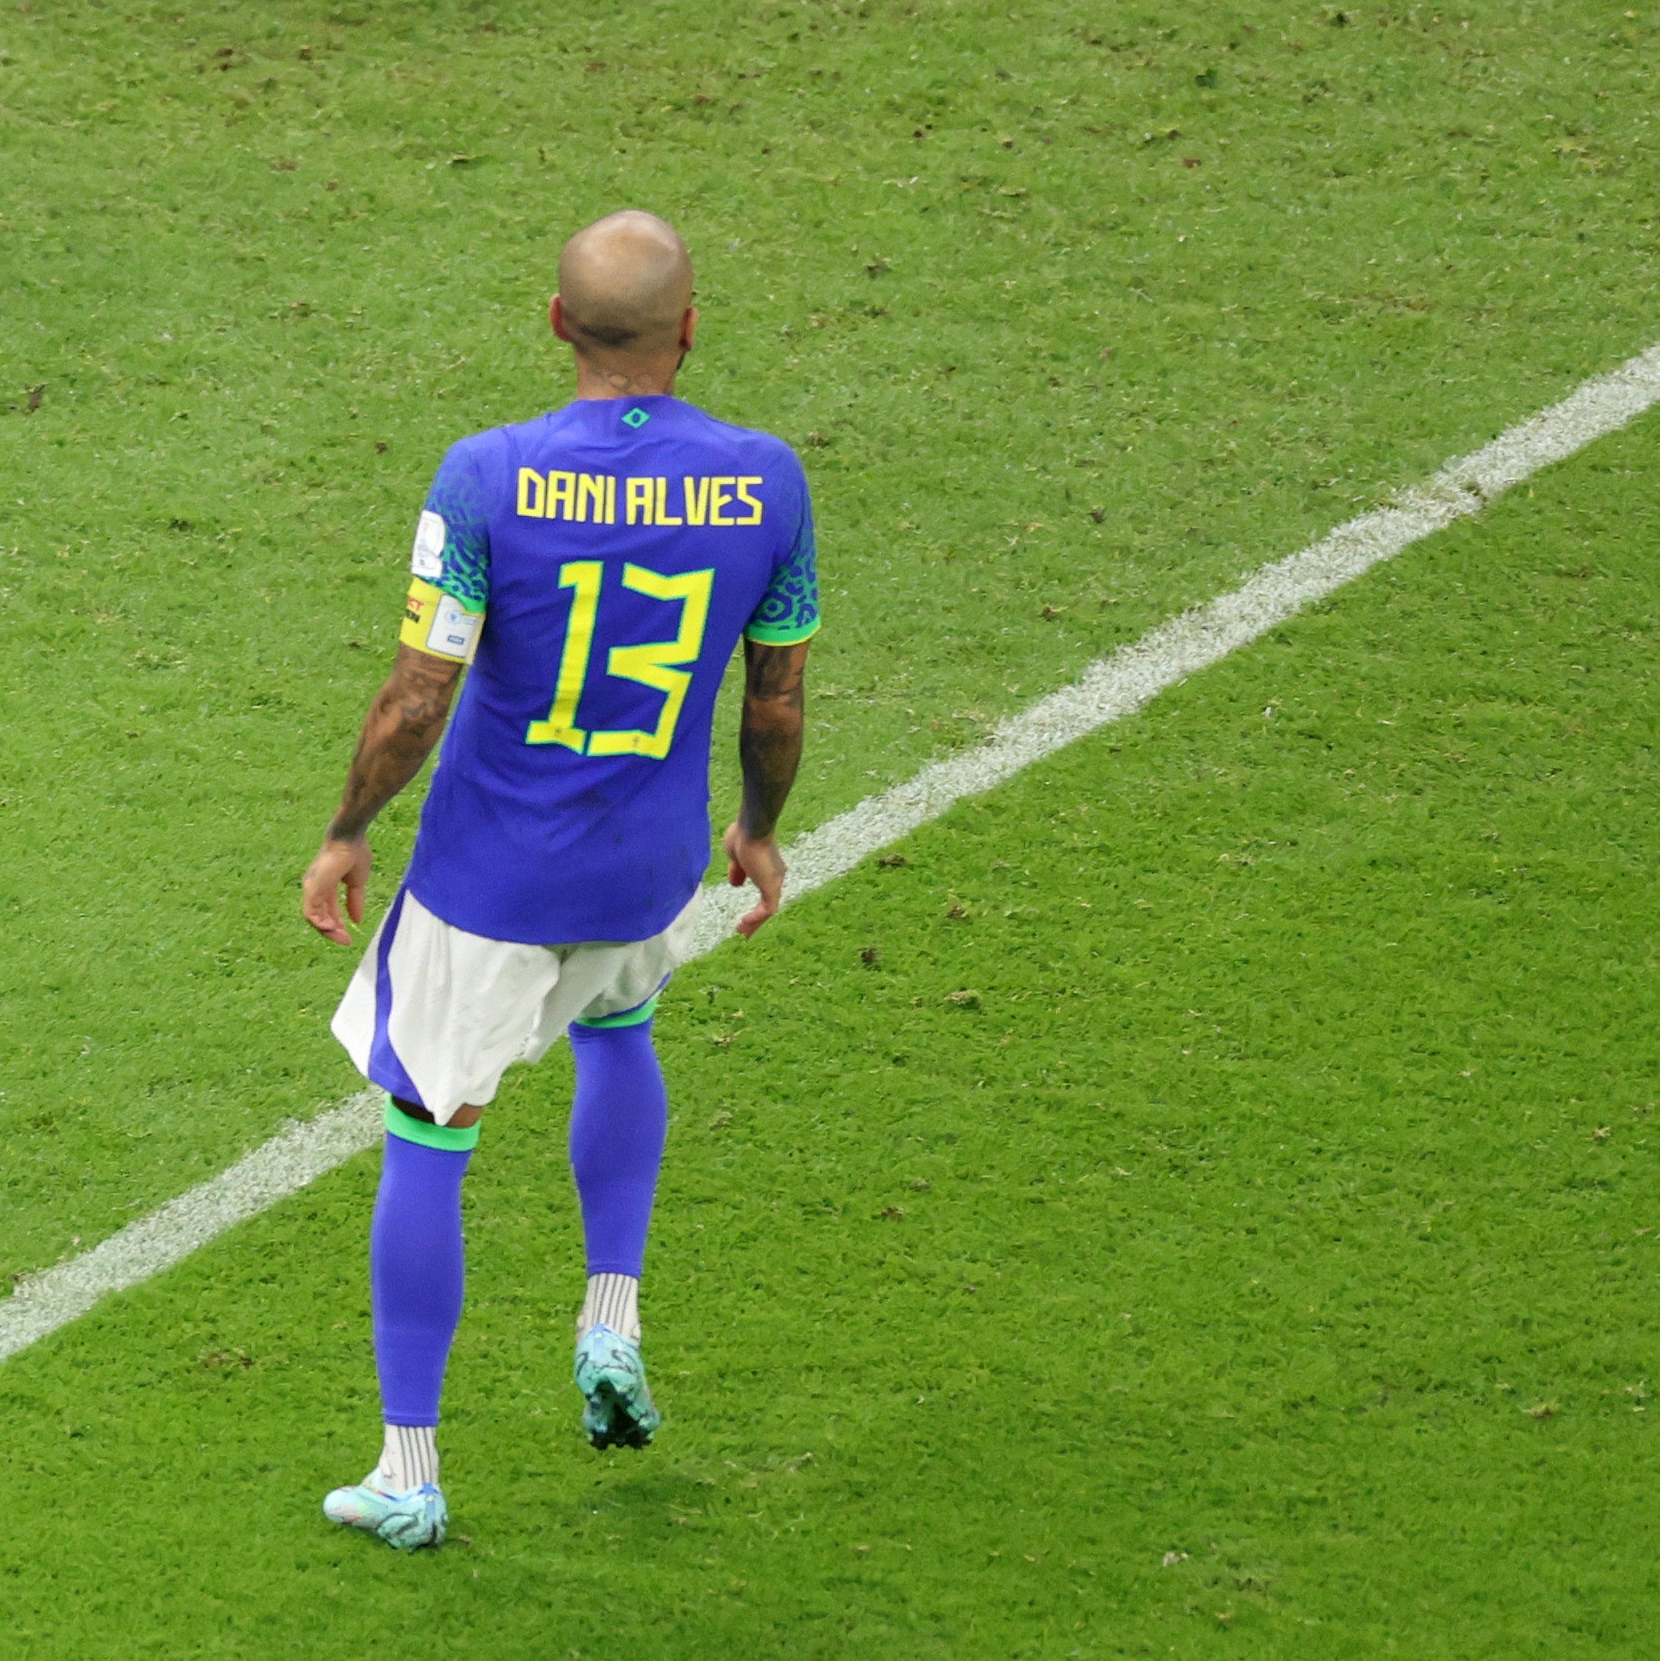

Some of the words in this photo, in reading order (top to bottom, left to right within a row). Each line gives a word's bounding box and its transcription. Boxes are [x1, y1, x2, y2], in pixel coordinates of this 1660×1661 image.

[516, 467, 616, 525] DANI
[626, 475, 764, 526] ALVES
[525, 560, 716, 761] 13
